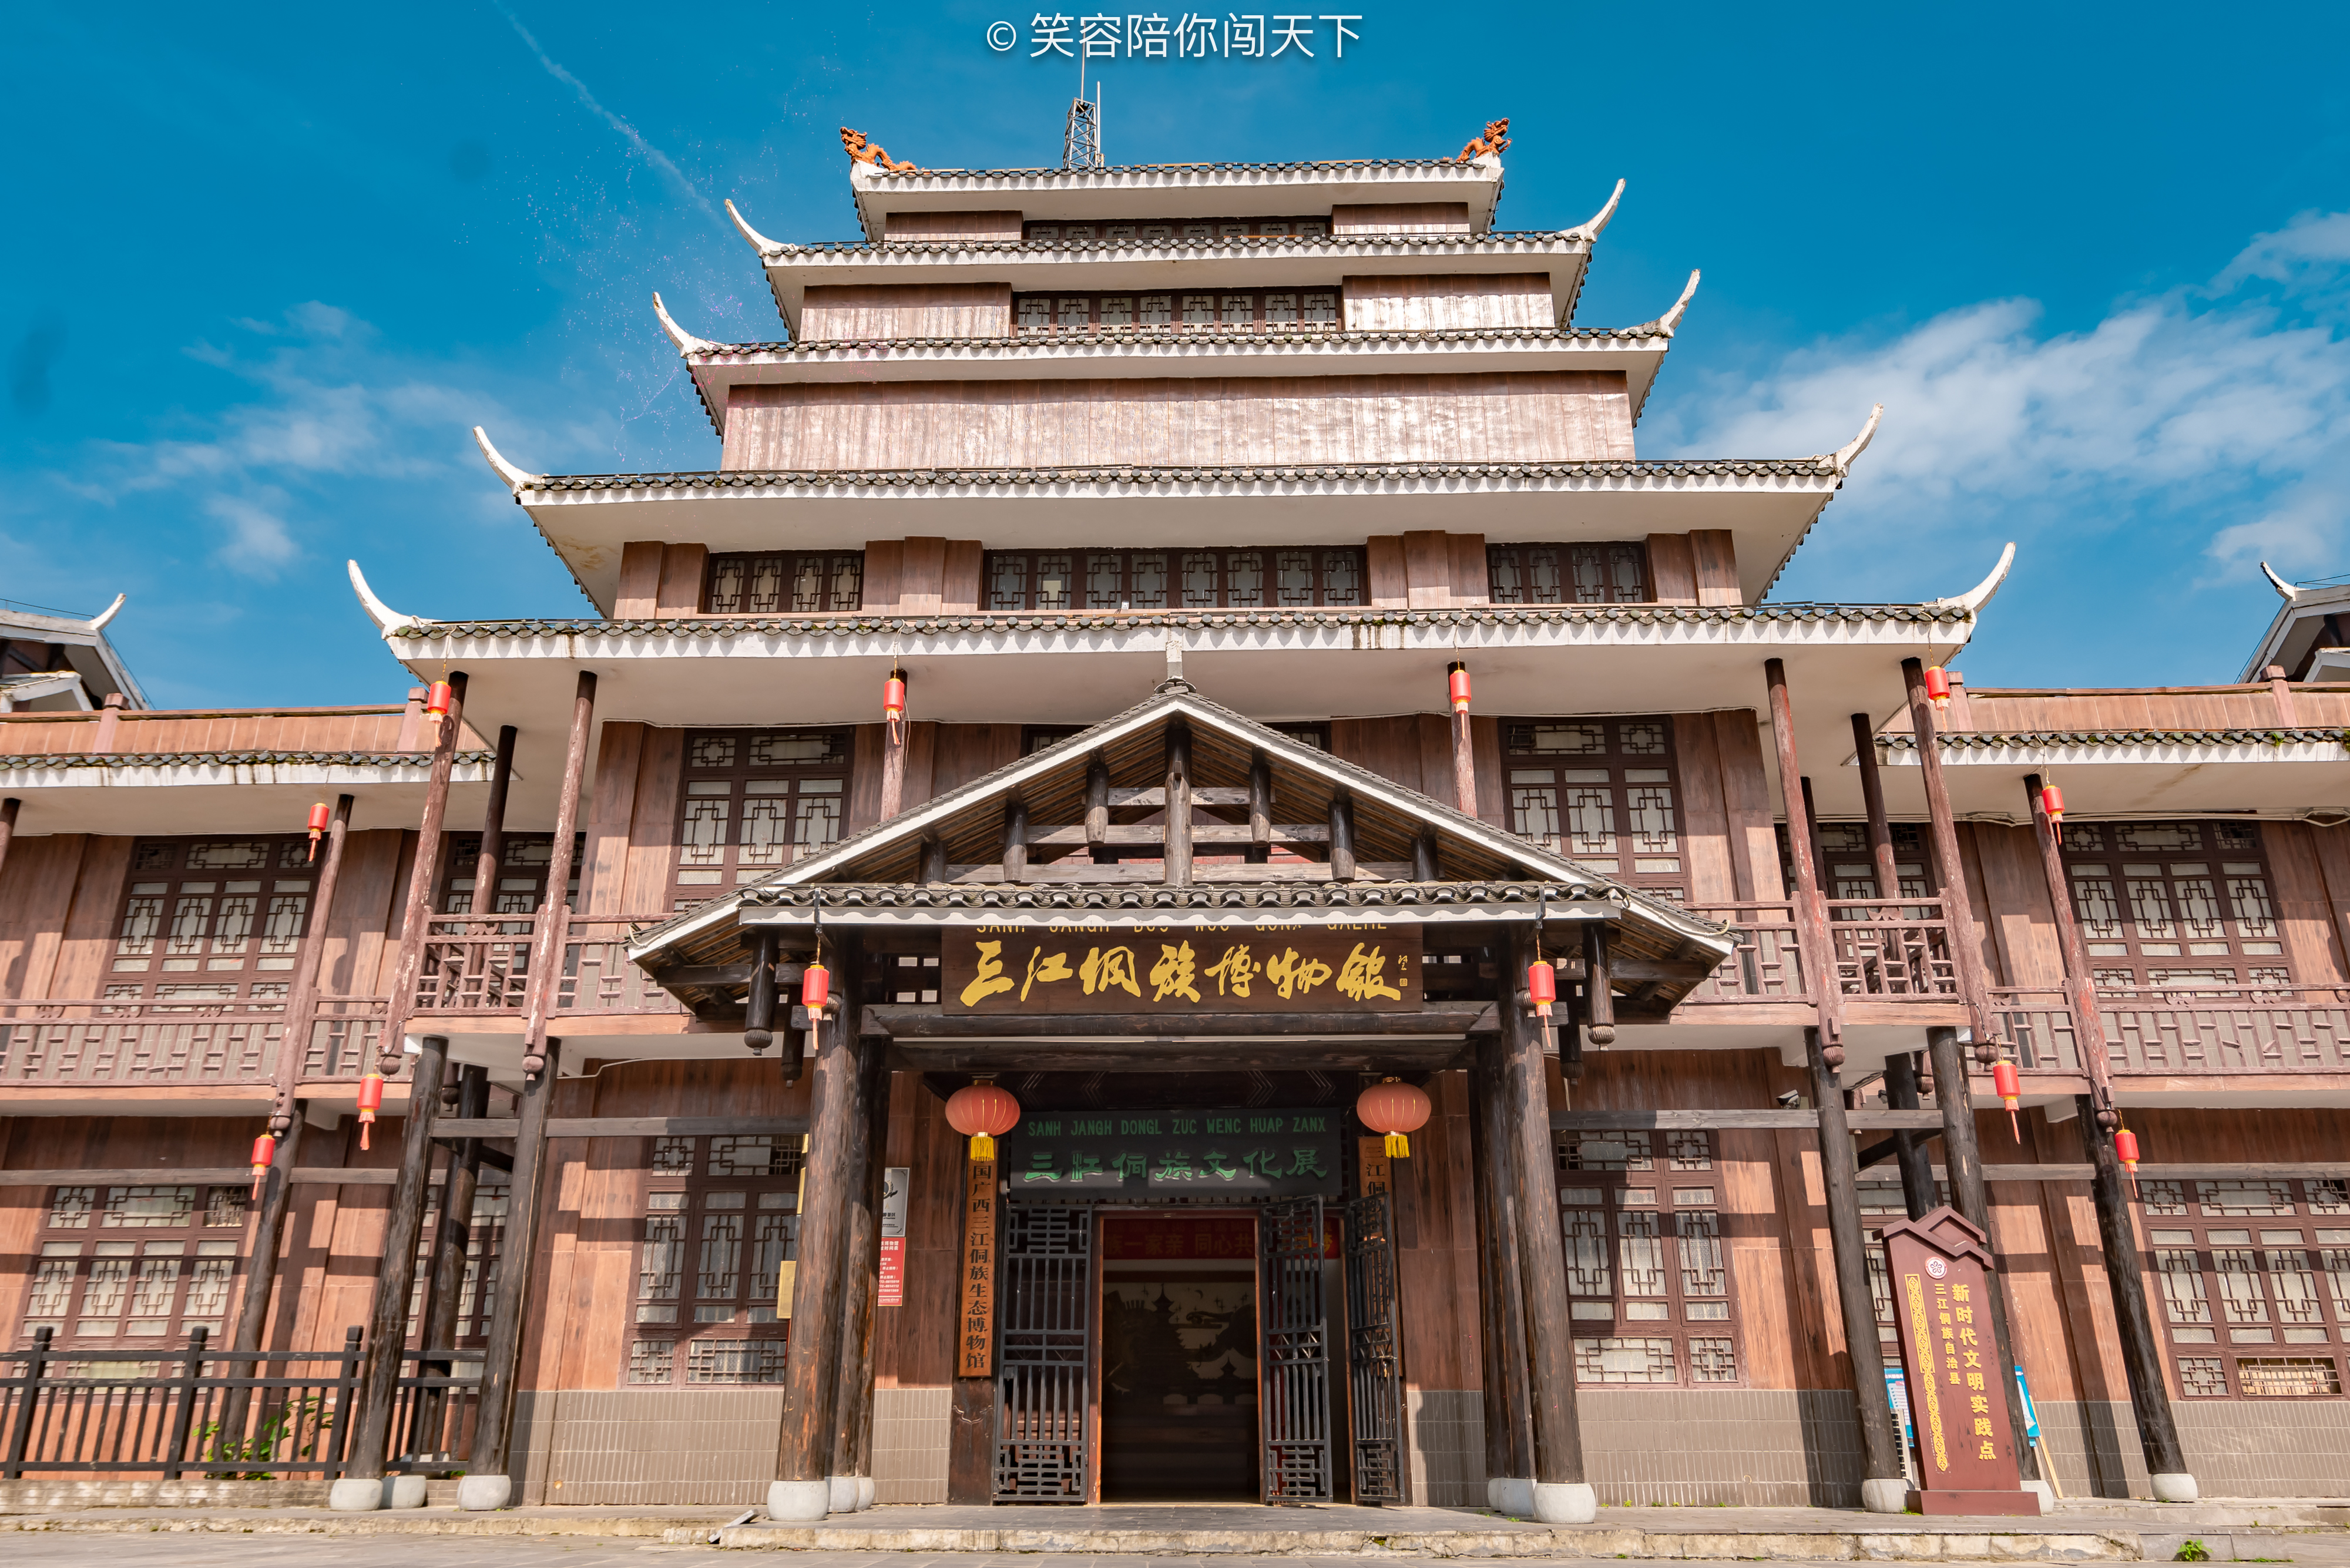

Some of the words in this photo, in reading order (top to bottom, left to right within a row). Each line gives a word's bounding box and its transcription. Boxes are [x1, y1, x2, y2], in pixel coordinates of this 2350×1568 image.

[1028, 1121, 1061, 1136] SANH
[1070, 1120, 1112, 1136] JANGH
[1120, 1119, 1162, 1135] DONGL
[1172, 1119, 1197, 1134] ZUC
[1206, 1118, 1241, 1134] WENC
[1250, 1117, 1283, 1133] HUAP
[1292, 1117, 1326, 1132] ZANX
[1023, 1149, 1327, 1181] 三江侗族文化展
[965, 1160, 992, 1369] 国广西三江侗族生态博物馆
[1104, 1233, 1184, 1256] 族一家亲
[1935, 1283, 1961, 1385] 三江侗族自治县
[1952, 1284, 1996, 1460] 新时代文明实践点
